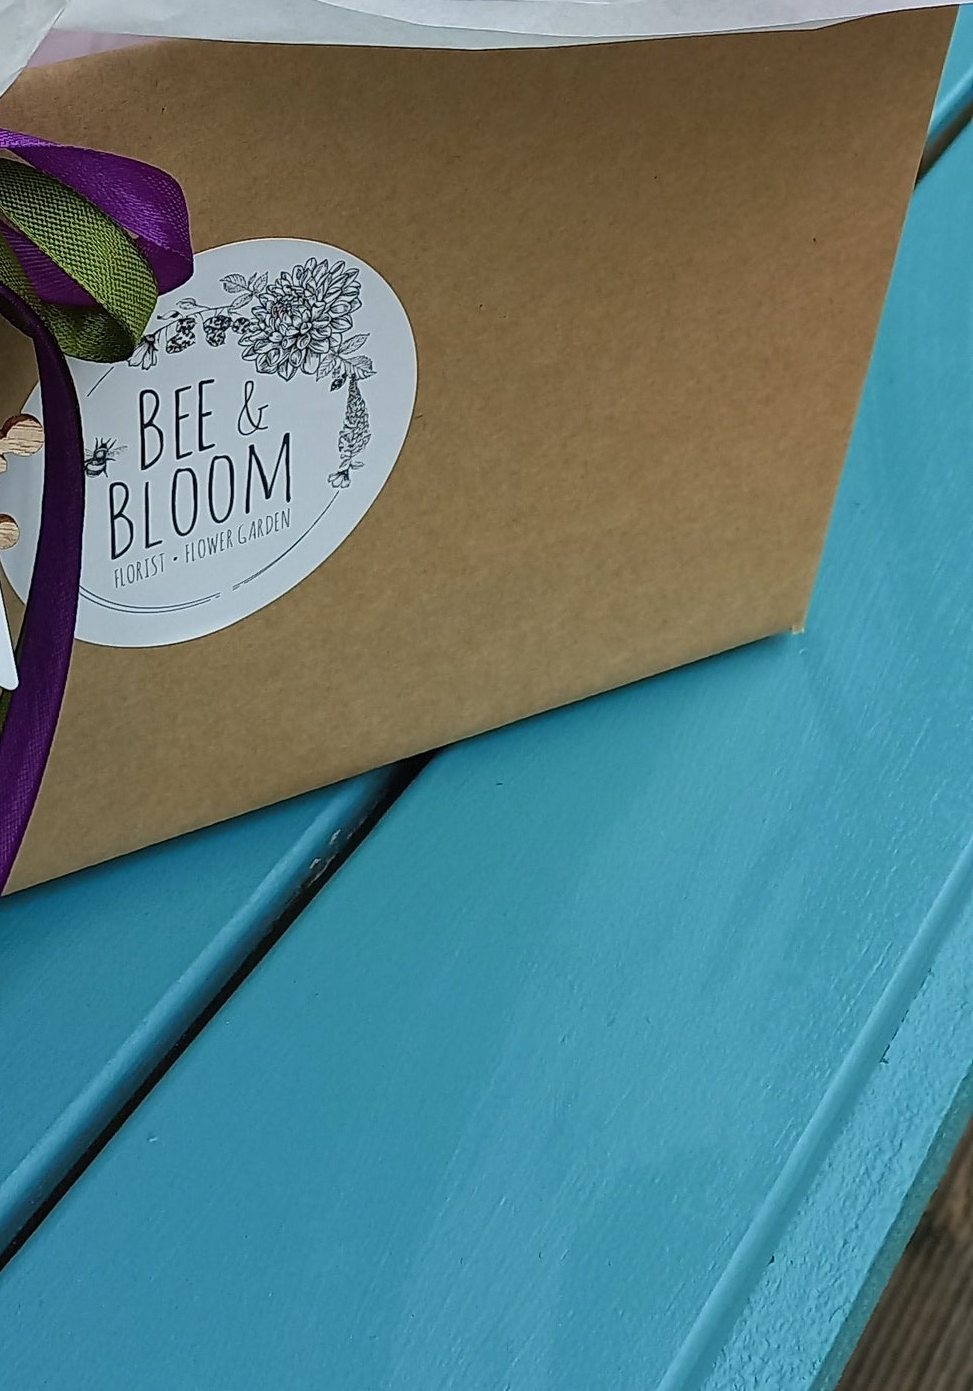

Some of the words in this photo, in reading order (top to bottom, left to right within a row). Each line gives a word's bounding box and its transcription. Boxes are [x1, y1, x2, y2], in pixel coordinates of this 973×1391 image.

[137, 377, 217, 472] BEE
[236, 379, 270, 437] &
[108, 432, 293, 561] BLOOM
[114, 553, 166, 589] FLORIST
[185, 528, 234, 563] FLOWER
[237, 508, 291, 545] GARDEN
